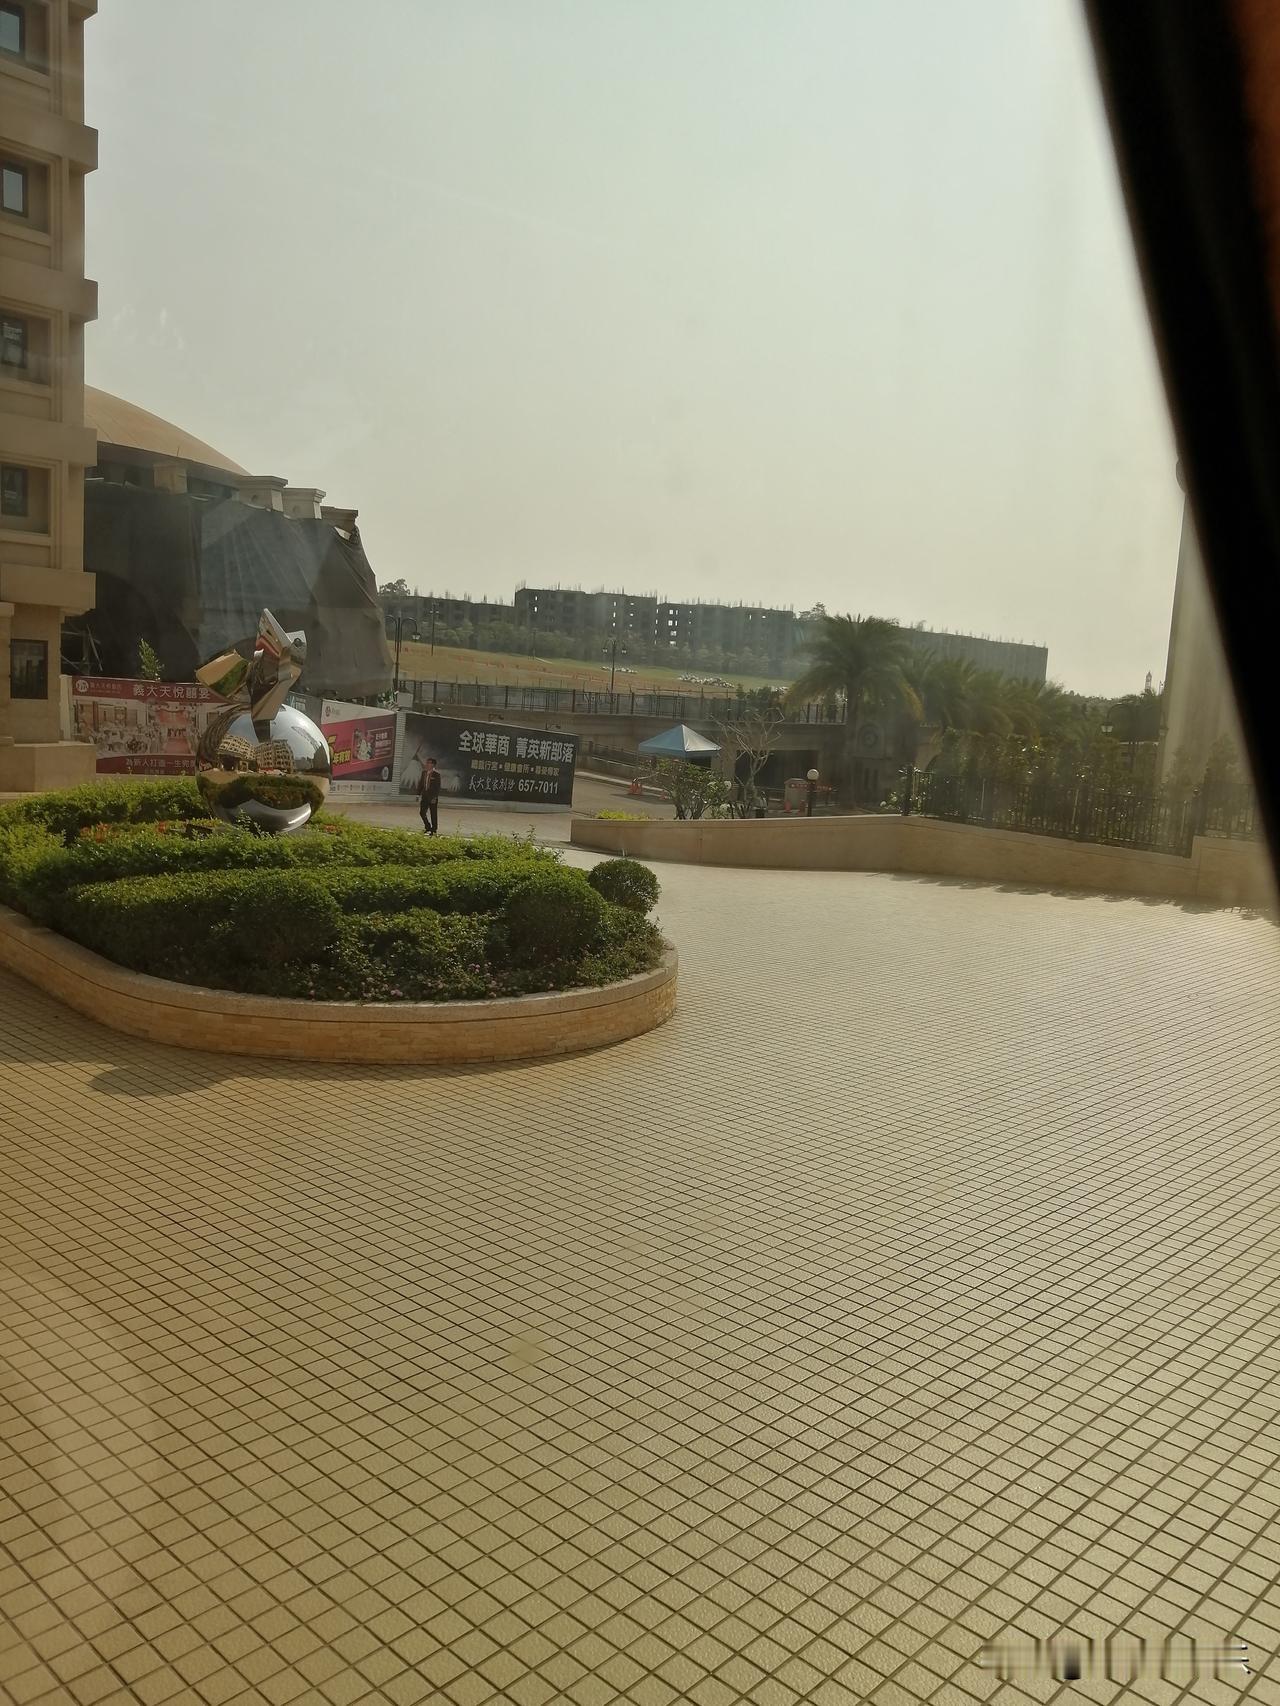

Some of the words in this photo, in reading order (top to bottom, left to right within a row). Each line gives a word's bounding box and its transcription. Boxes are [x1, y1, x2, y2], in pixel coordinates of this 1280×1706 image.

[132, 684, 210, 700] 義大天悅囍宴
[458, 730, 511, 757] 全球華商
[516, 737, 574, 764] 菁英新部落
[518, 778, 559, 795] 657-7011
